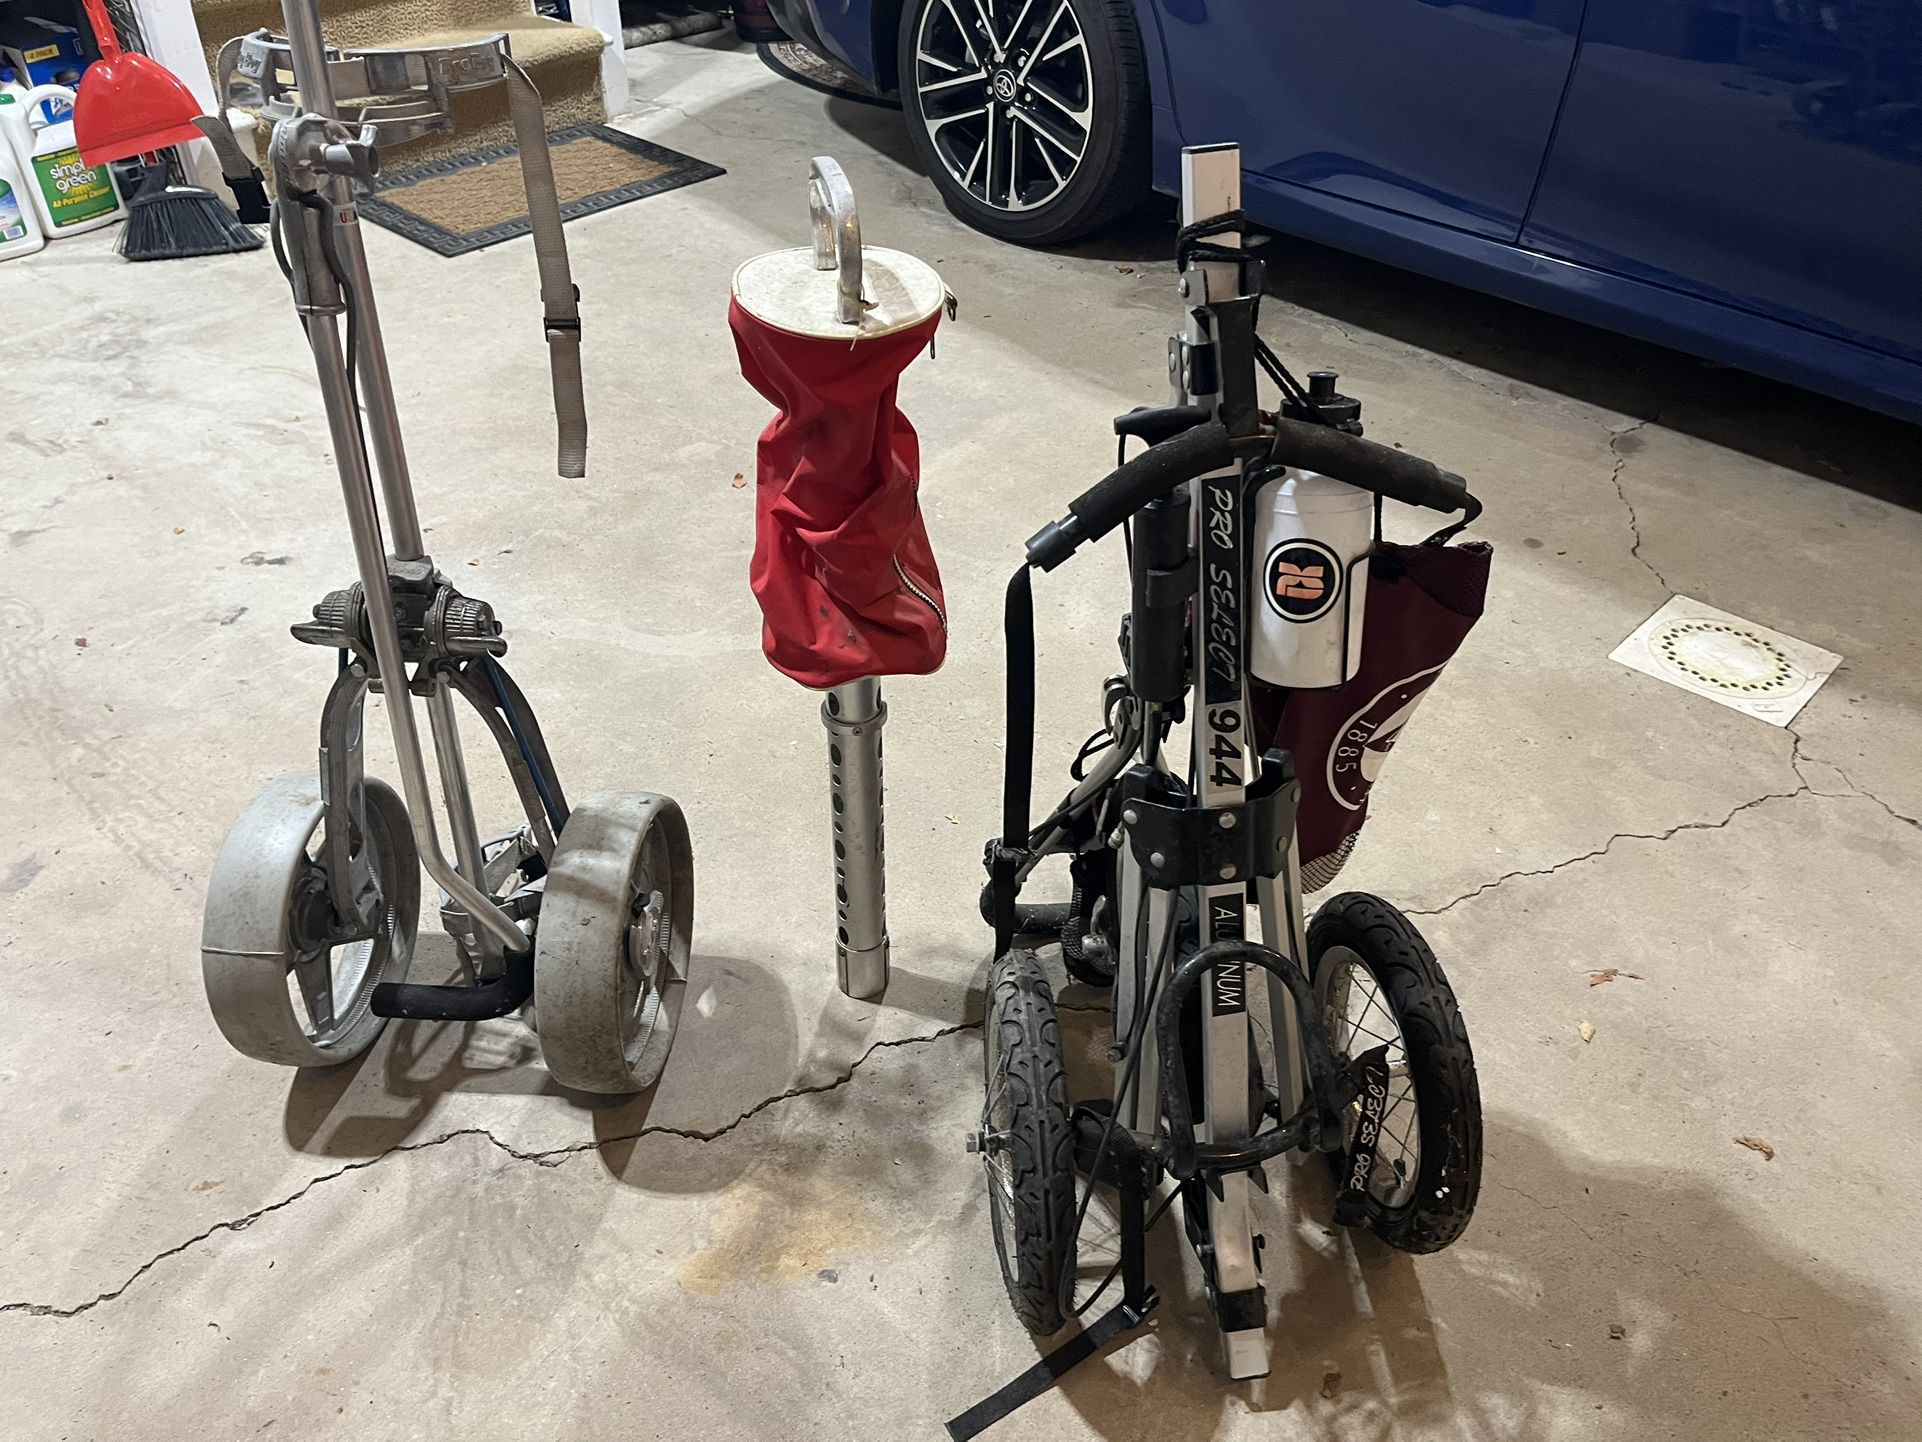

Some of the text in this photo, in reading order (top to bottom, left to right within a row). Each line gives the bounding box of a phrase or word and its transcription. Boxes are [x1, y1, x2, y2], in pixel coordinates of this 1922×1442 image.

[49, 158, 85, 179] simpl
[56, 171, 97, 194] green
[1207, 485, 1237, 683] PRO SELECT
[1207, 708, 1242, 789] 944
[1335, 720, 1378, 773] 1885
[1214, 905, 1242, 1007] ALUNUM
[1350, 1065, 1386, 1192] PRO SELECT
